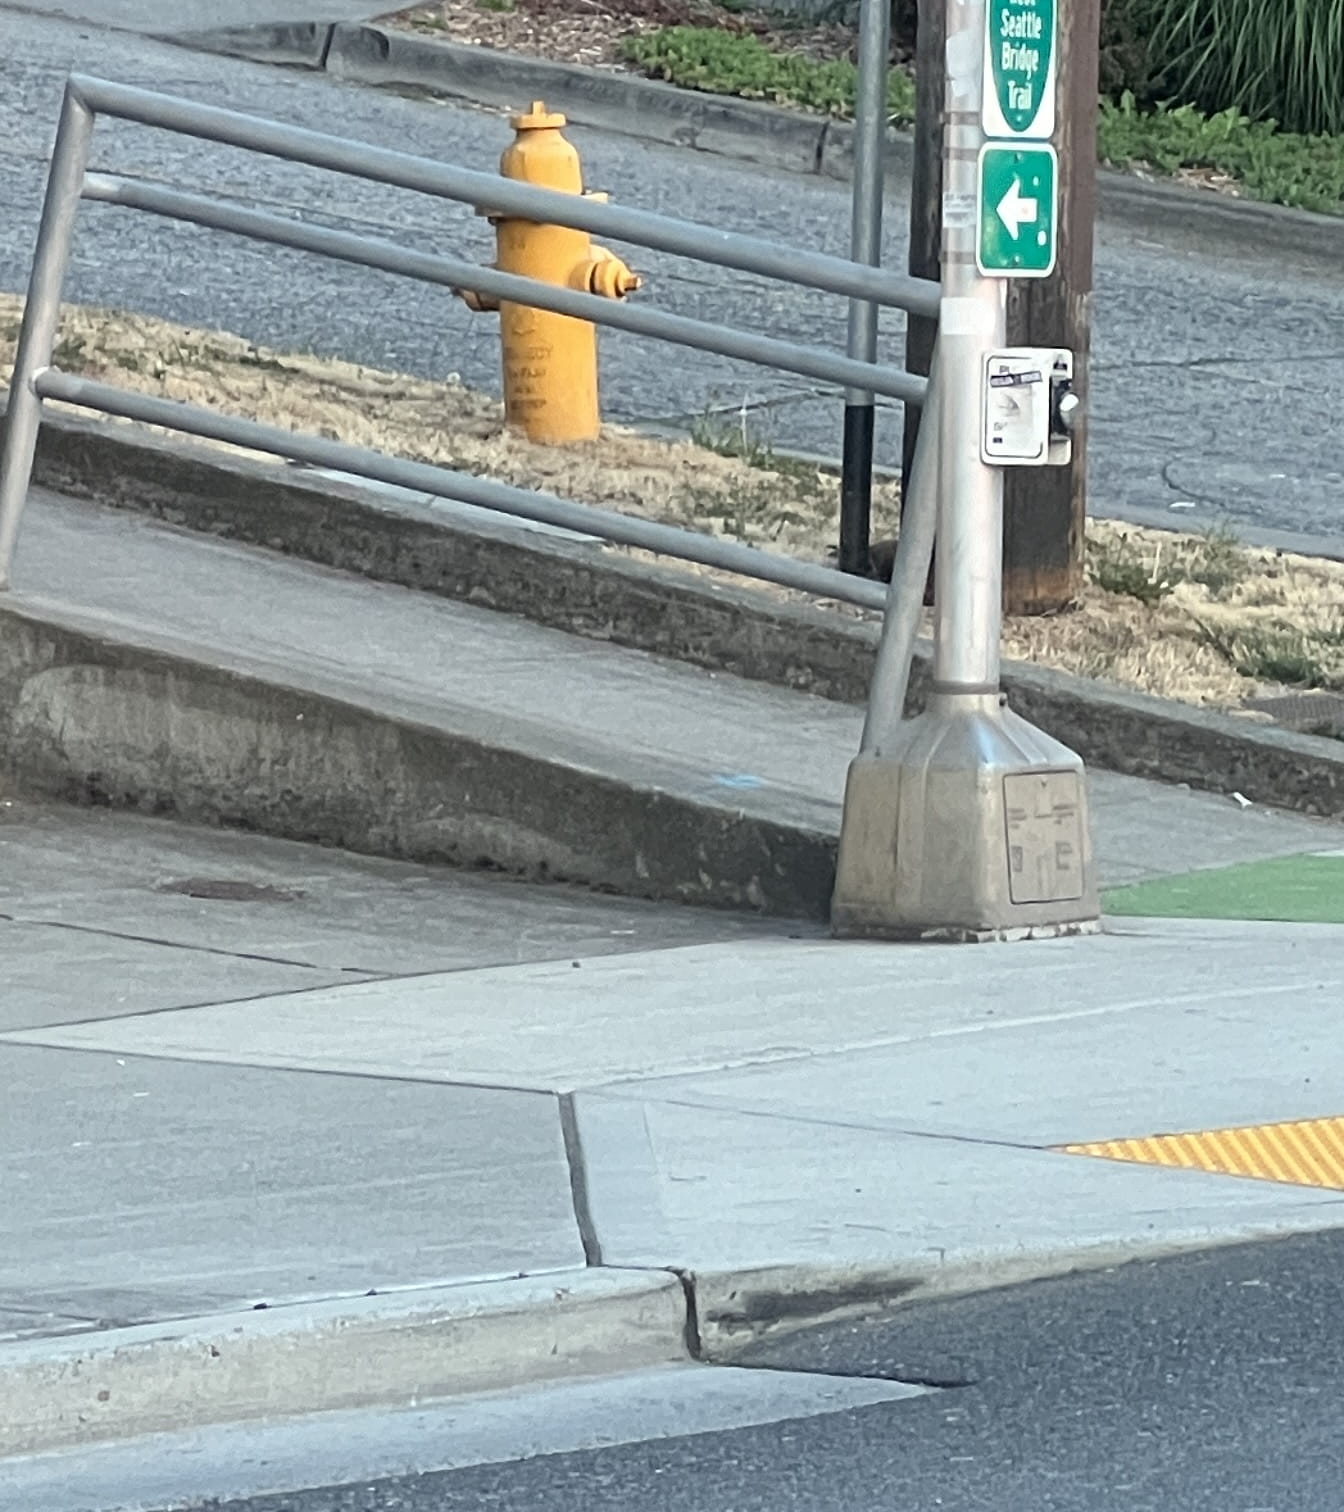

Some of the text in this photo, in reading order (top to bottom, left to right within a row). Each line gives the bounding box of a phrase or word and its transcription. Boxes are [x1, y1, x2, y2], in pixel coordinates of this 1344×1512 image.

[1000, 8, 1042, 39] Seattle
[1001, 41, 1039, 81] Bridge
[1007, 80, 1032, 110] Trail
